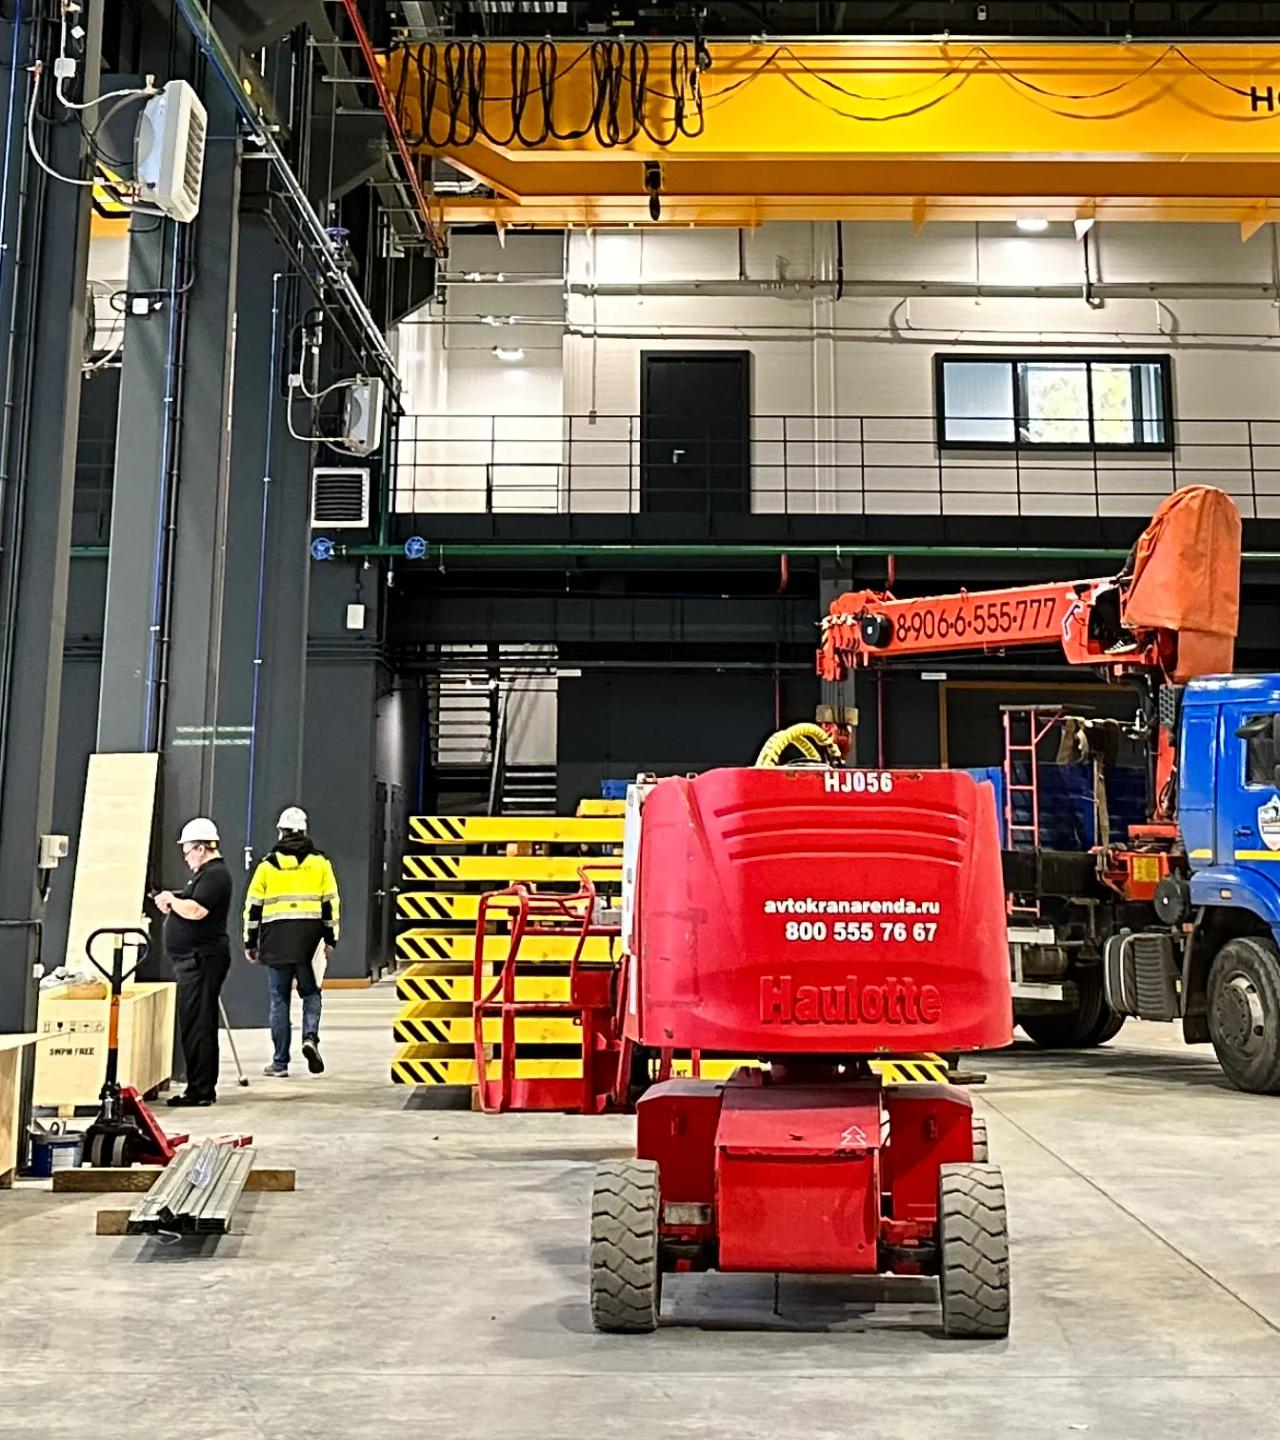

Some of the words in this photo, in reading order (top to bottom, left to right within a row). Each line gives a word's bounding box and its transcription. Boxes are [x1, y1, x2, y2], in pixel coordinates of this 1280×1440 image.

[823, 771, 894, 794] HJ056
[763, 897, 941, 915] avtokranarenda.ru
[784, 920, 828, 942] 800
[832, 921, 874, 942] 555
[879, 921, 908, 942] 76
[912, 922, 938, 942] 67
[758, 973, 942, 1026] Haulotte
